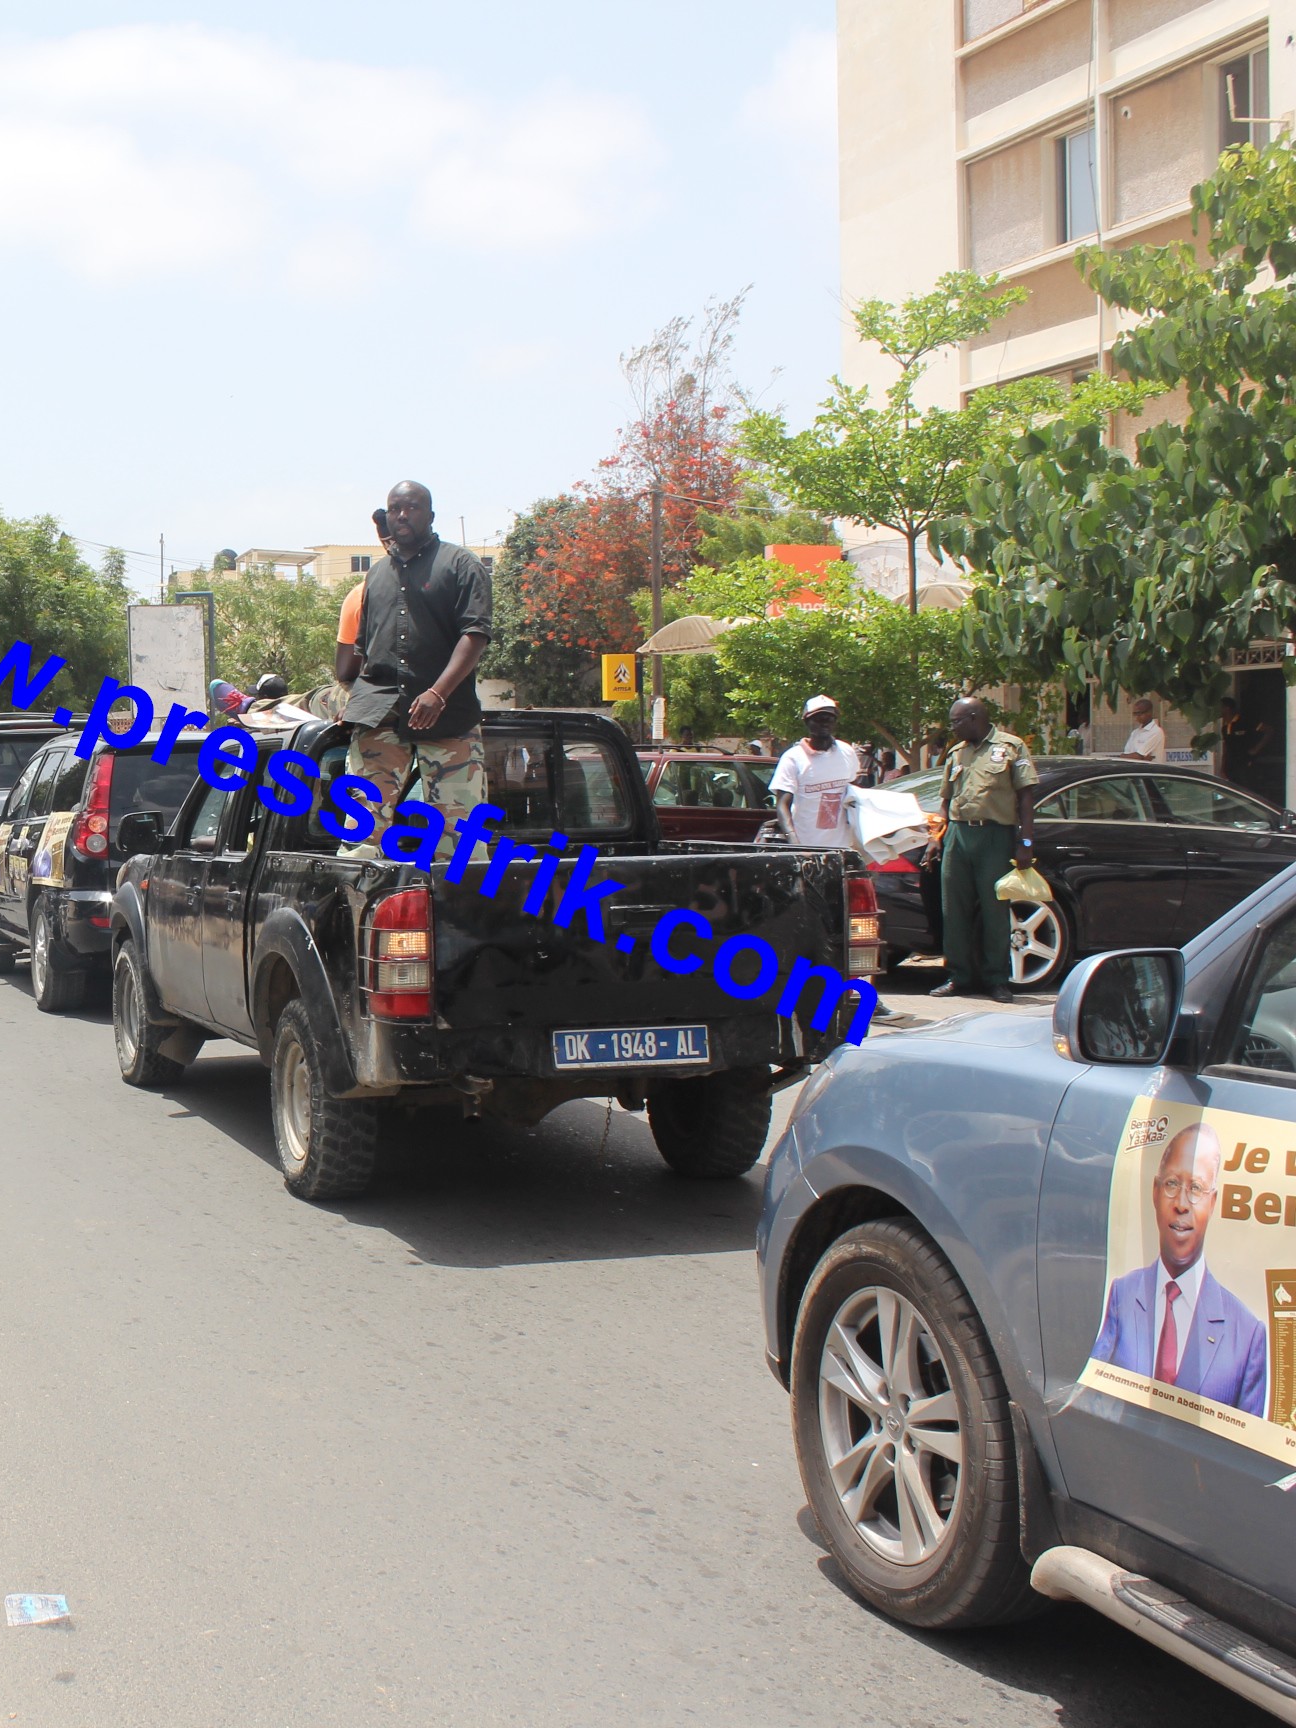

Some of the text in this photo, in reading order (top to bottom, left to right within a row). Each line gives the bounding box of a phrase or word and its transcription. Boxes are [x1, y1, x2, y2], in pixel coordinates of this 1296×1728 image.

[1130, 1119, 1157, 1130] Benno
[1223, 1142, 1271, 1174] Je
[1152, 1388, 1175, 1402] Boun
[1177, 1397, 1215, 1417] Abdallah
[1217, 1411, 1246, 1429] Dionne
